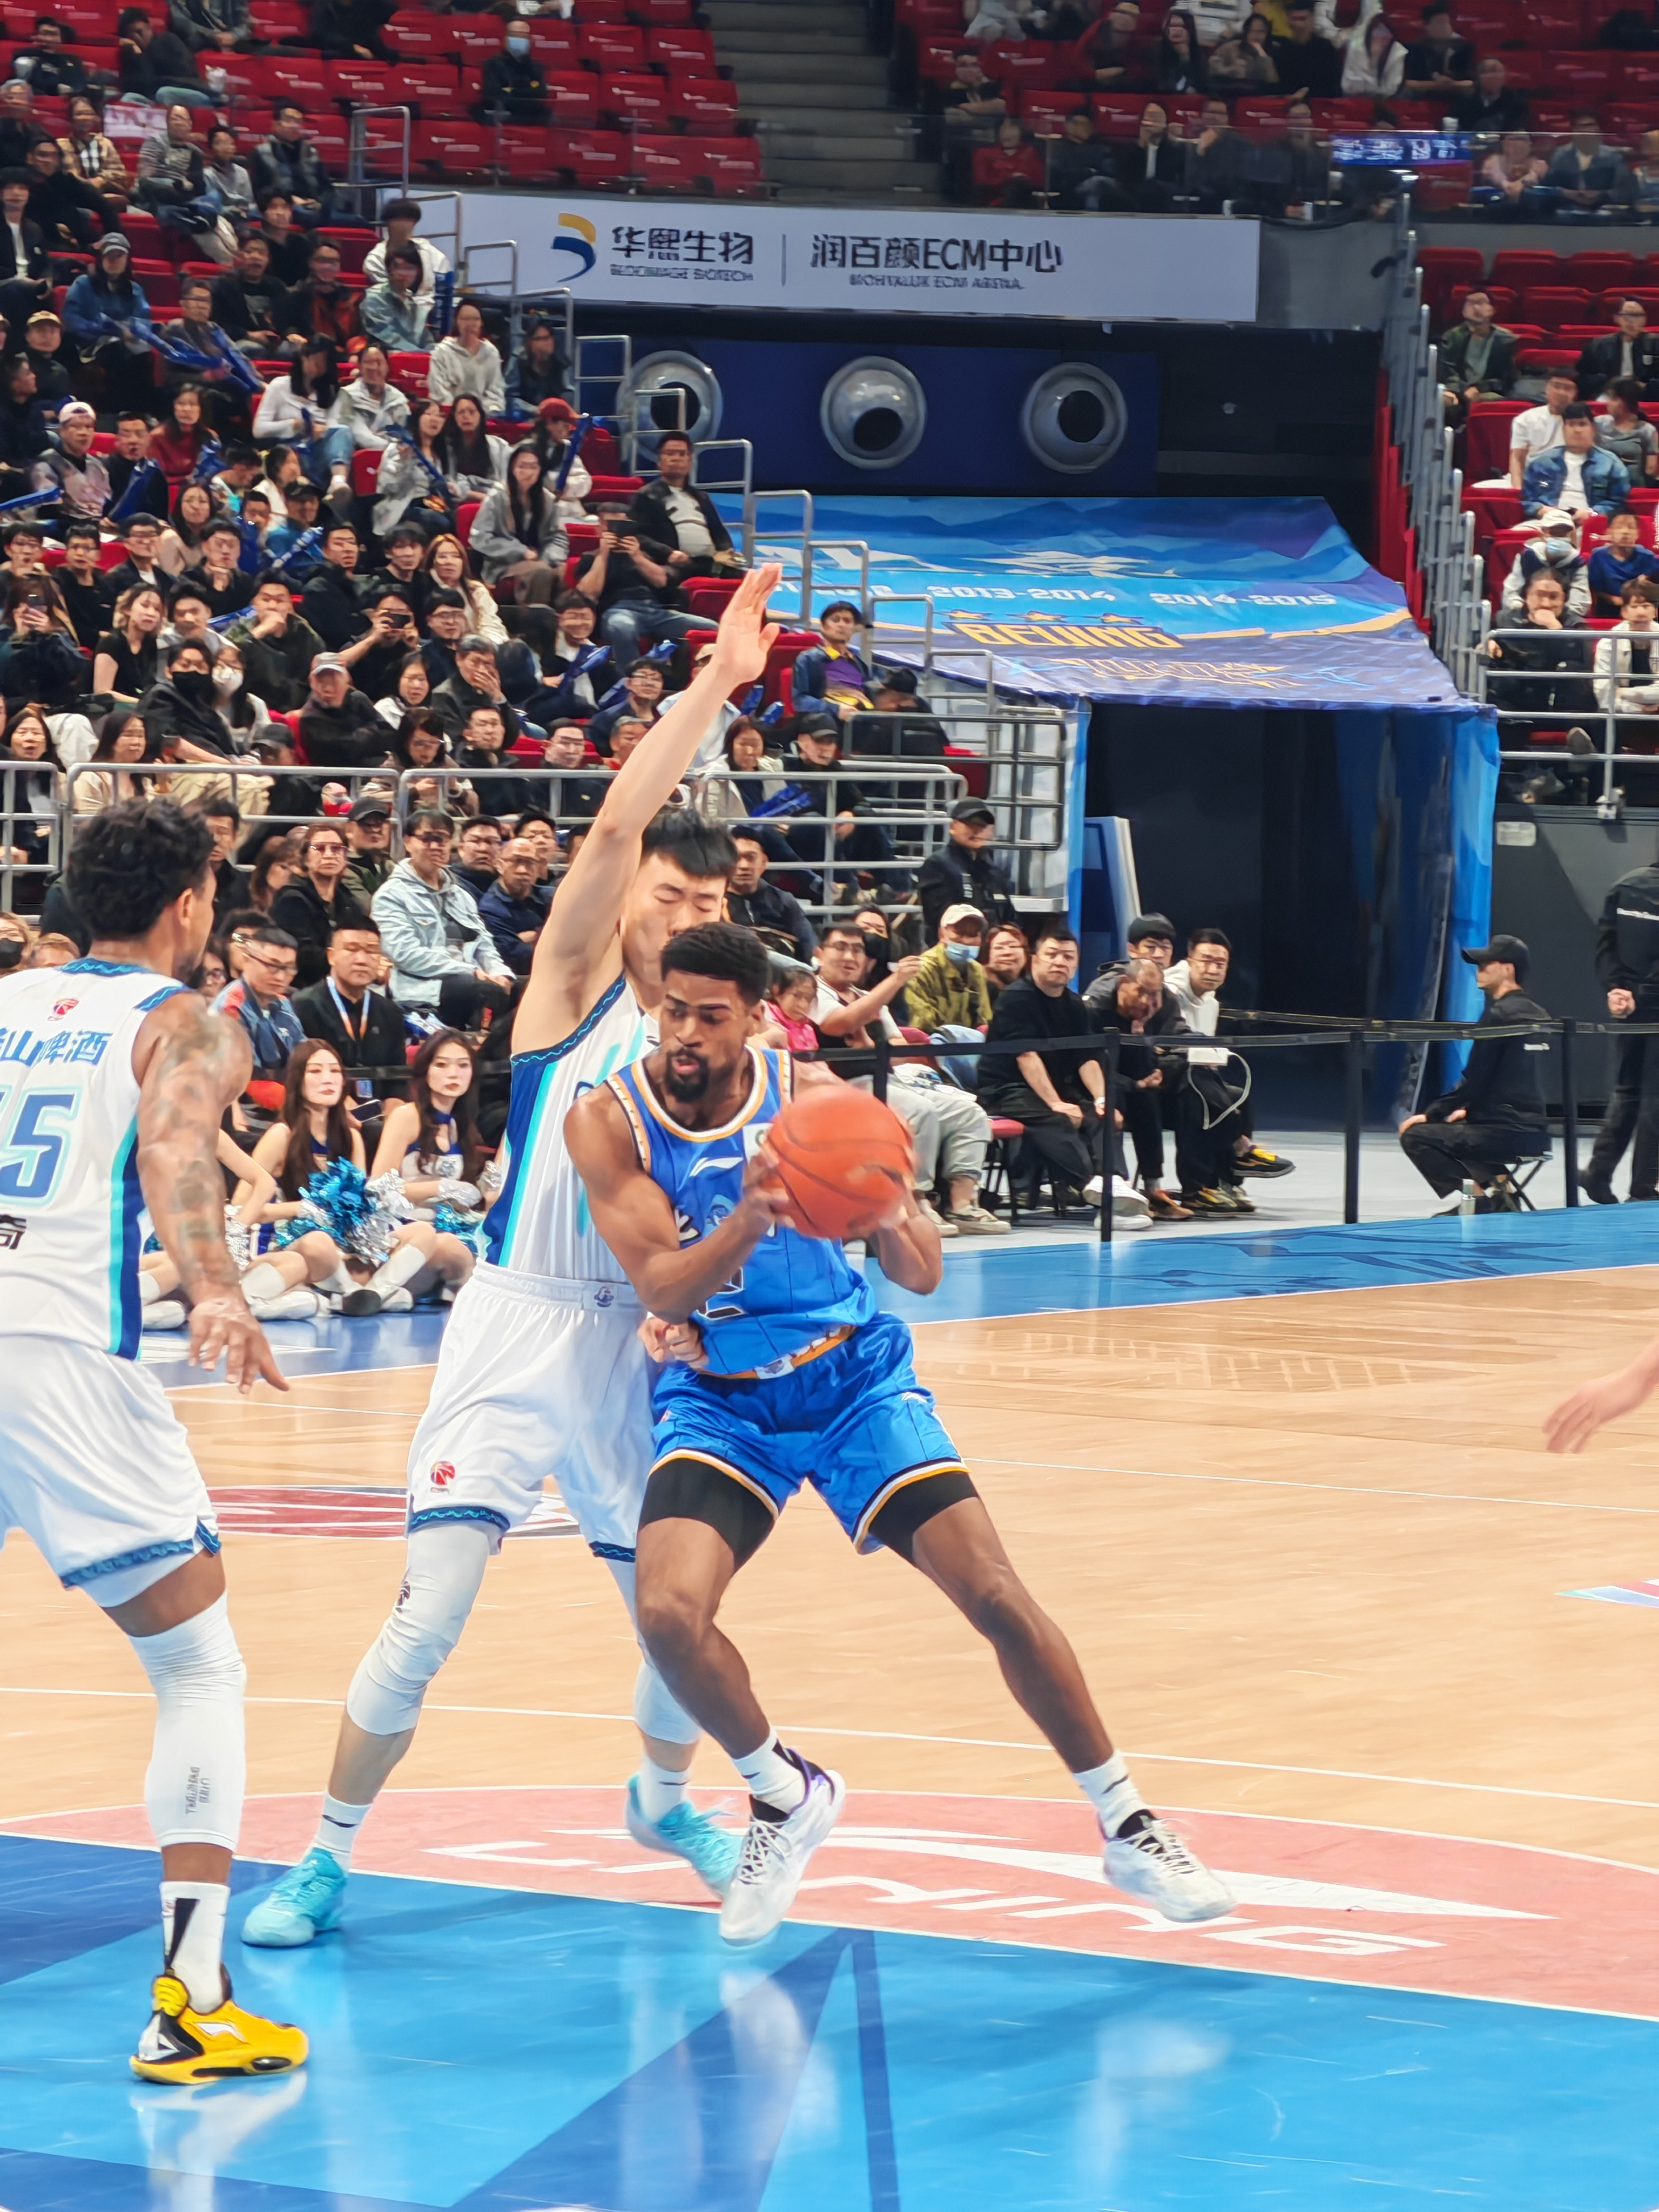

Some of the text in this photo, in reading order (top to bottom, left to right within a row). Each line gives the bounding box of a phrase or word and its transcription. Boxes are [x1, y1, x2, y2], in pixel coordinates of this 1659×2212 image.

[611, 226, 754, 265] 华熙生物
[810, 233, 1064, 273] 润百颜ECM中心
[927, 585, 1116, 602] 2013-2014
[1149, 592, 1337, 606] 2014-2015
[949, 622, 1186, 649] BEIJING
[0, 1028, 113, 1067] 山啤酒
[0, 1084, 83, 1208] 5
[421, 1840, 1448, 1956] LINING
